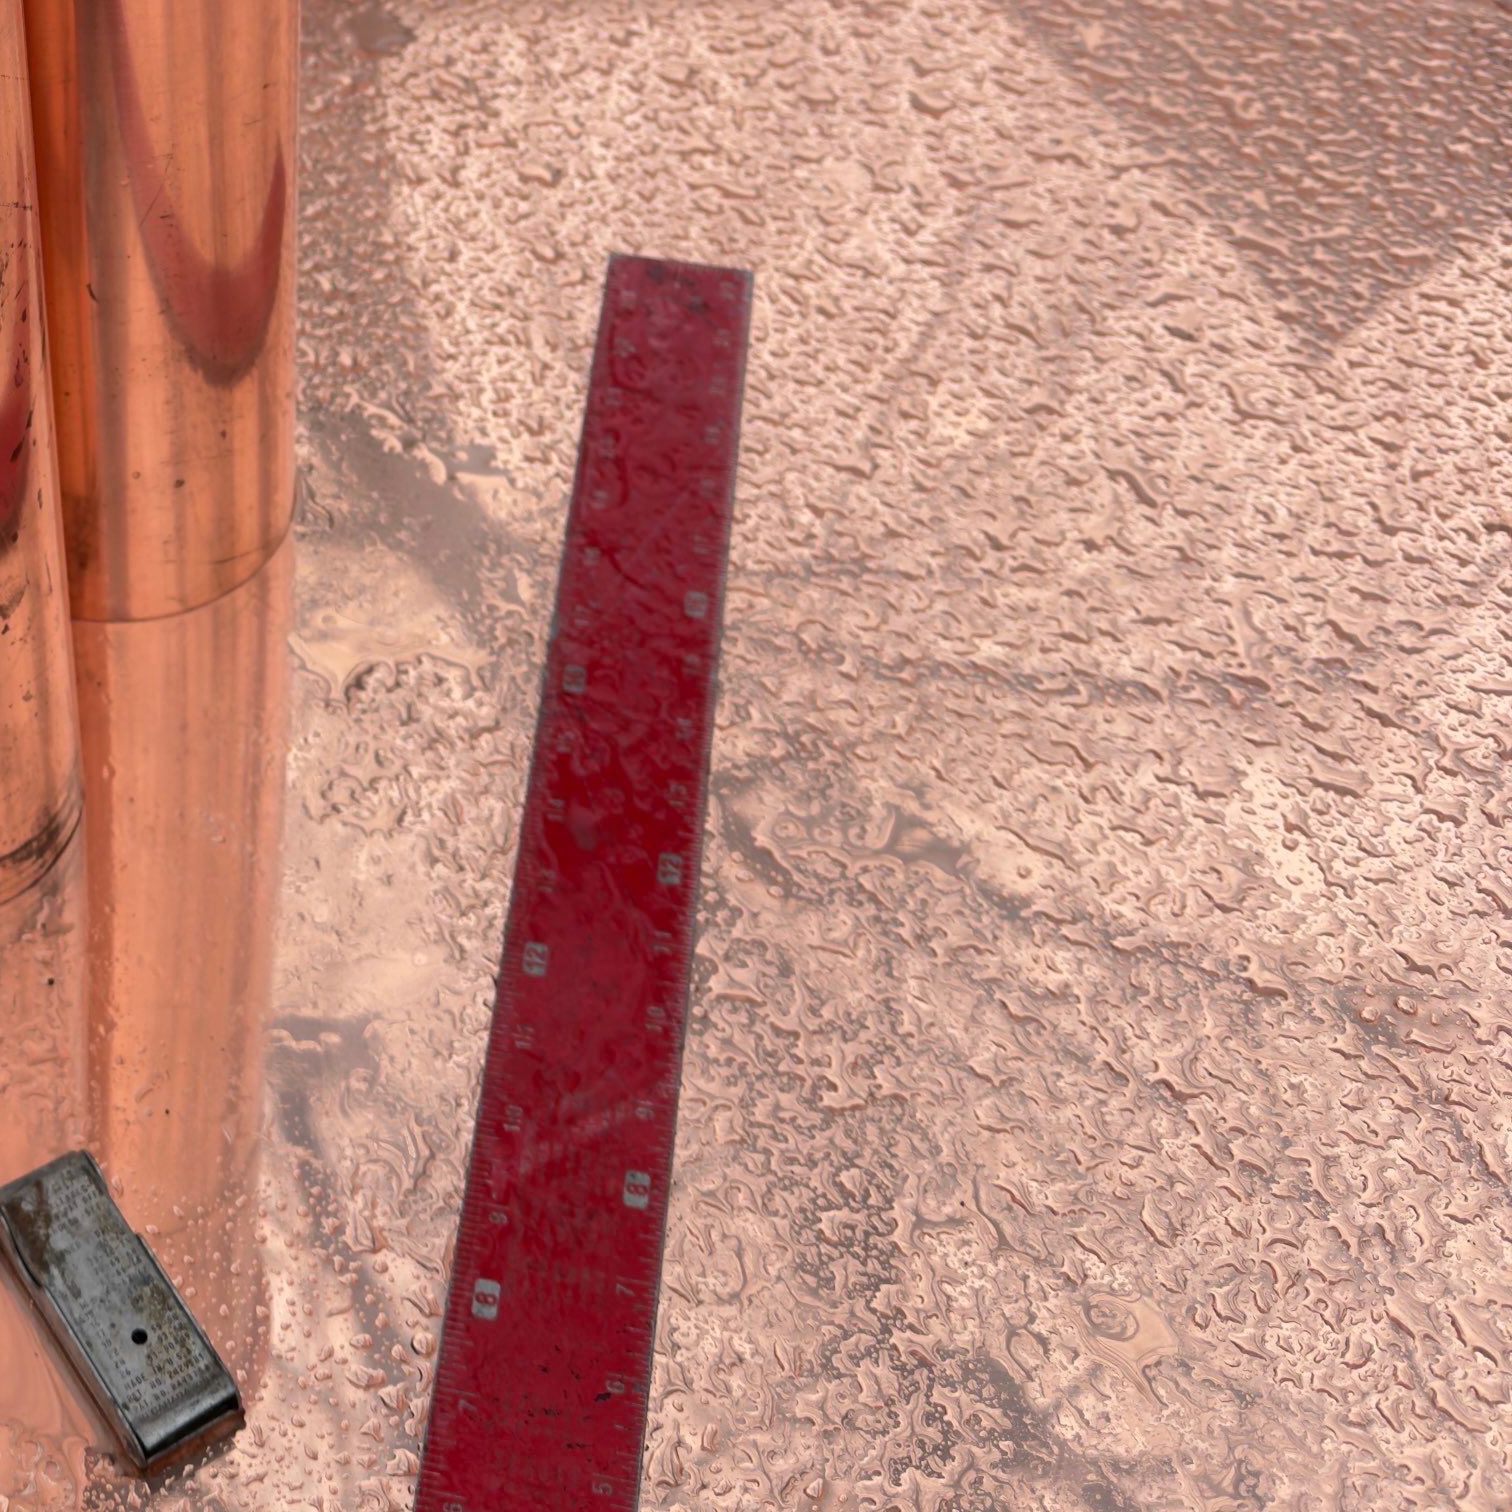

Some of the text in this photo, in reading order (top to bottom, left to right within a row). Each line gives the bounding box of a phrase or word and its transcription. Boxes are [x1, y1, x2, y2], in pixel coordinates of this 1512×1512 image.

[124, 1372, 147, 1391] MADE
[458, 1399, 477, 1413] 7
[489, 1210, 508, 1225] 9
[503, 1104, 524, 1133] 10
[592, 1480, 613, 1497] 5
[605, 1379, 625, 1395] 6
[616, 1283, 635, 1297] 7
[645, 1005, 665, 1033] 10
